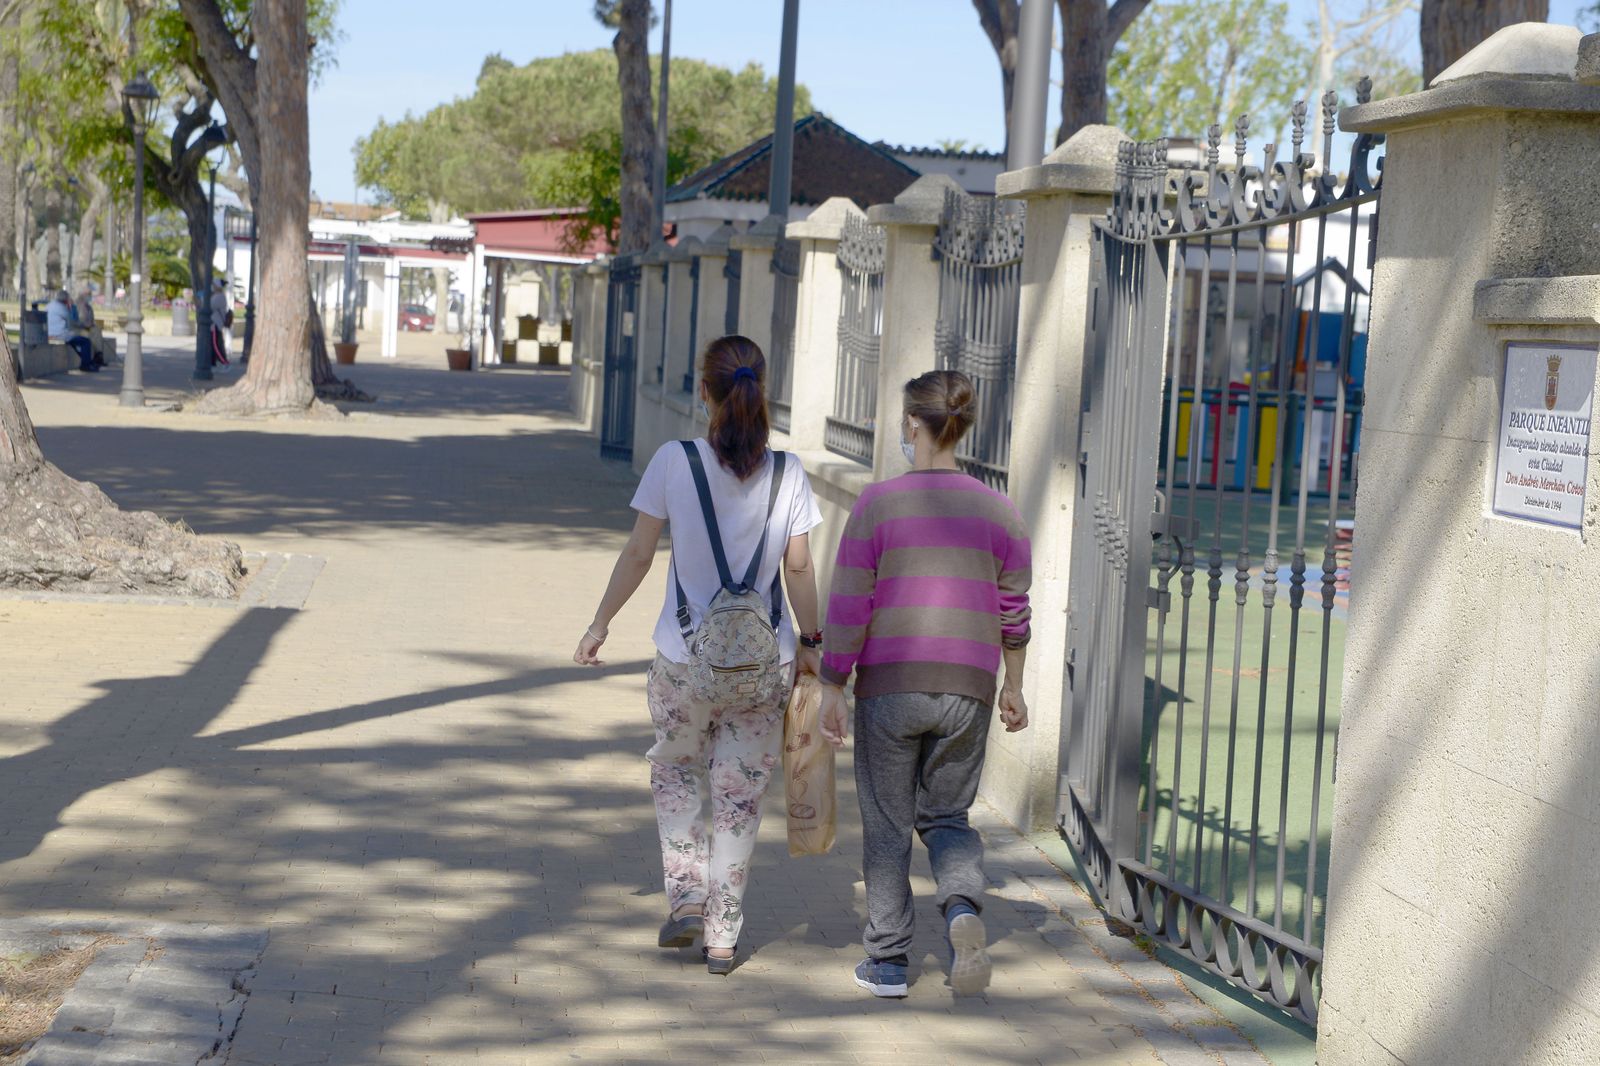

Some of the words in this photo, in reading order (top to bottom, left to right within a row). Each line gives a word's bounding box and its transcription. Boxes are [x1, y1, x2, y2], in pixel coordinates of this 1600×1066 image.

[1509, 412, 1546, 433] PARQUE
[1540, 438, 1559, 454] siendo
[1559, 440, 1581, 456] alcalde
[1528, 458, 1540, 470] esta
[1541, 458, 1564, 473] Ciudad
[1505, 471, 1518, 484] Don
[1518, 474, 1539, 489] Andrés
[1544, 500, 1550, 509] de
